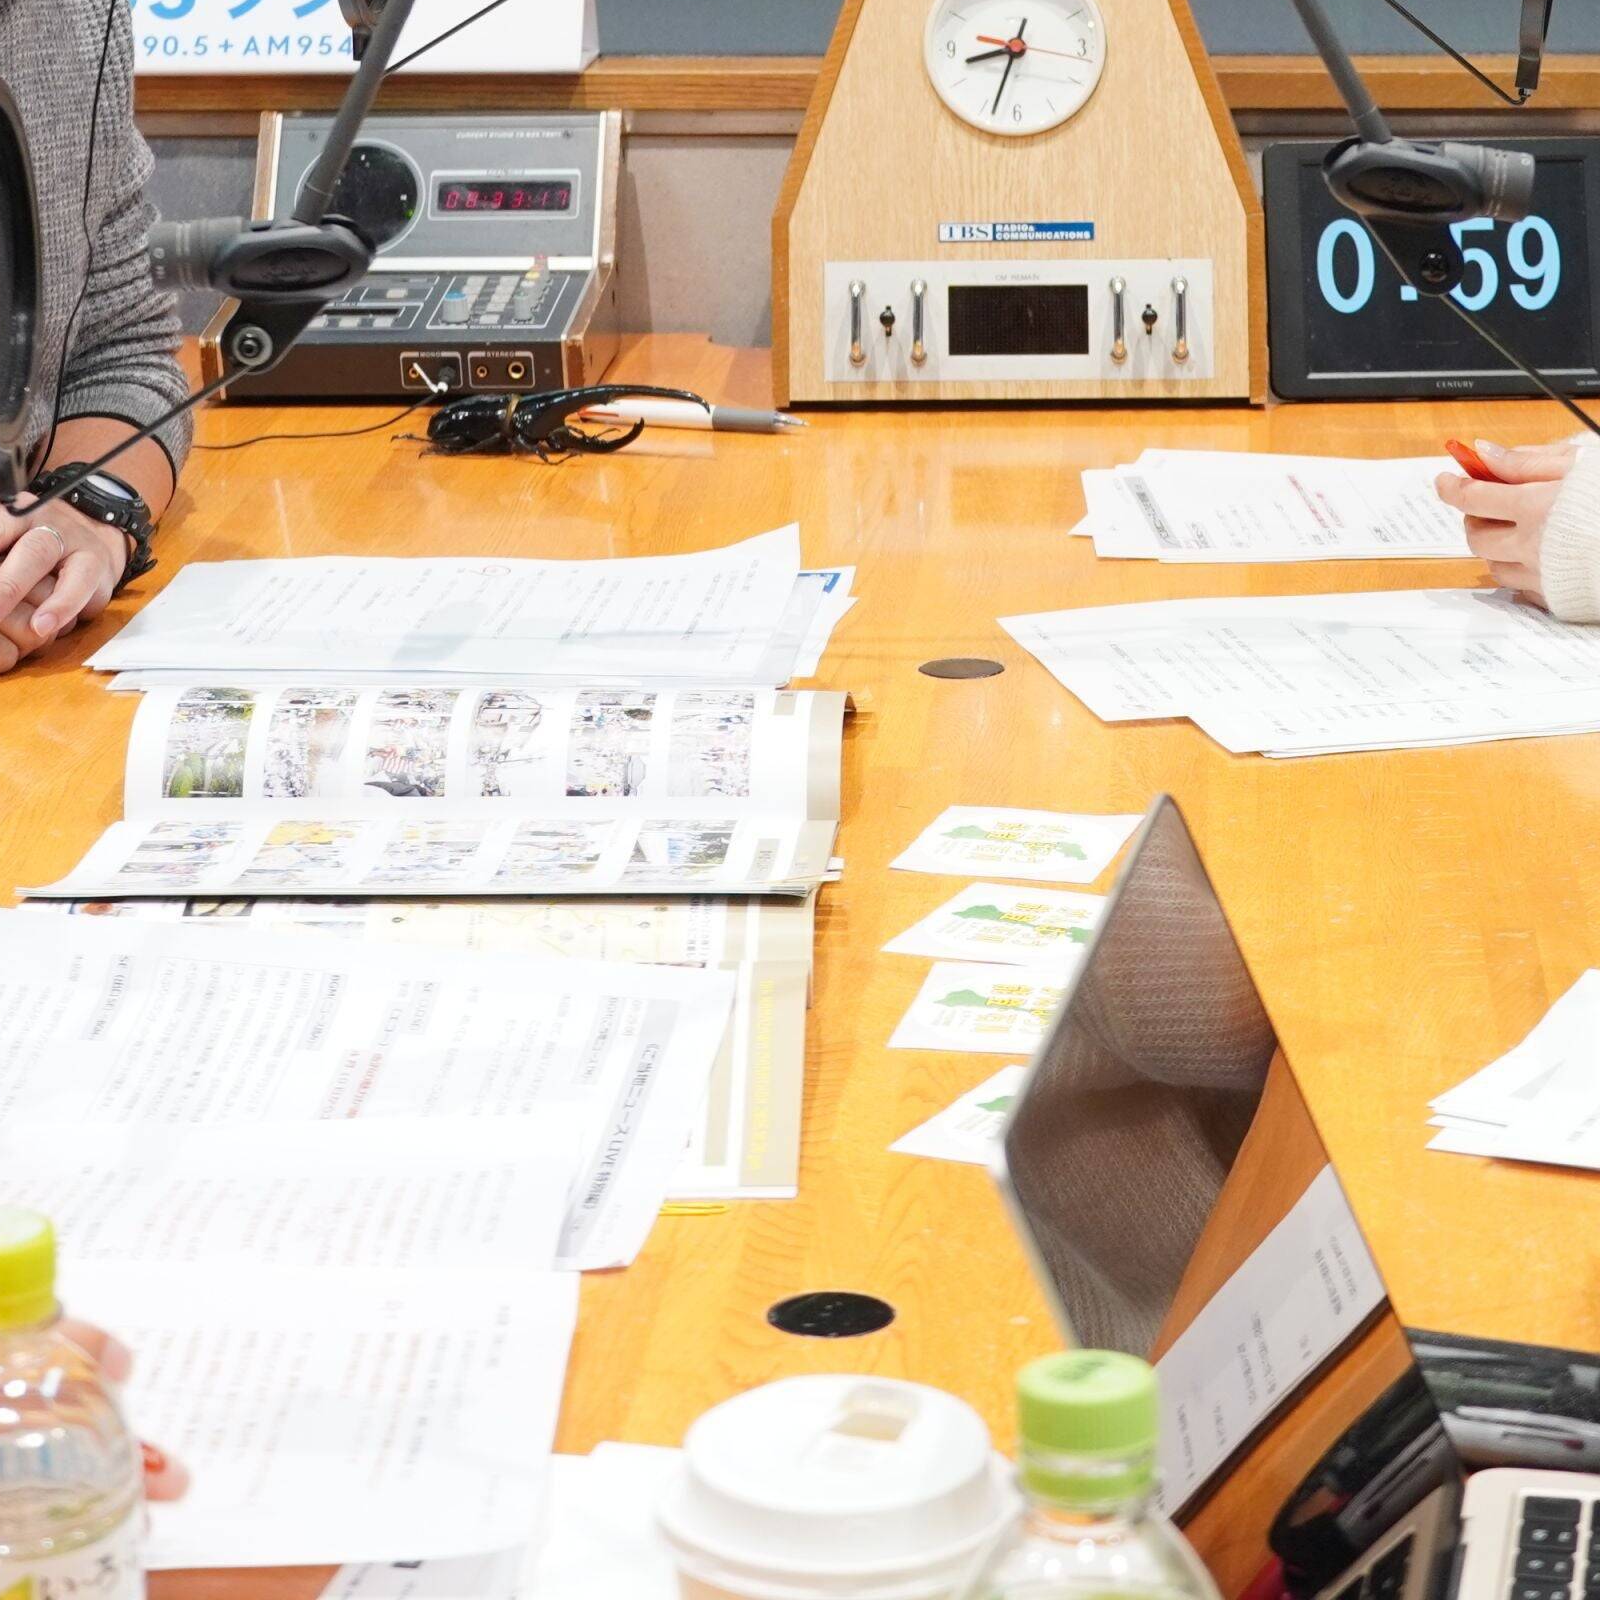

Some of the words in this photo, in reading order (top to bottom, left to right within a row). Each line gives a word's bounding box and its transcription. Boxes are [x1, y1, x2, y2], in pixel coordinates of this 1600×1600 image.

[946, 40, 956, 59] 9
[1077, 38, 1087, 57] 3
[1013, 104, 1022, 122] 6
[947, 225, 989, 239] TBS
[995, 231, 1091, 240] COMMUNICATIONS
[1436, 381, 1474, 389] CENTURY
